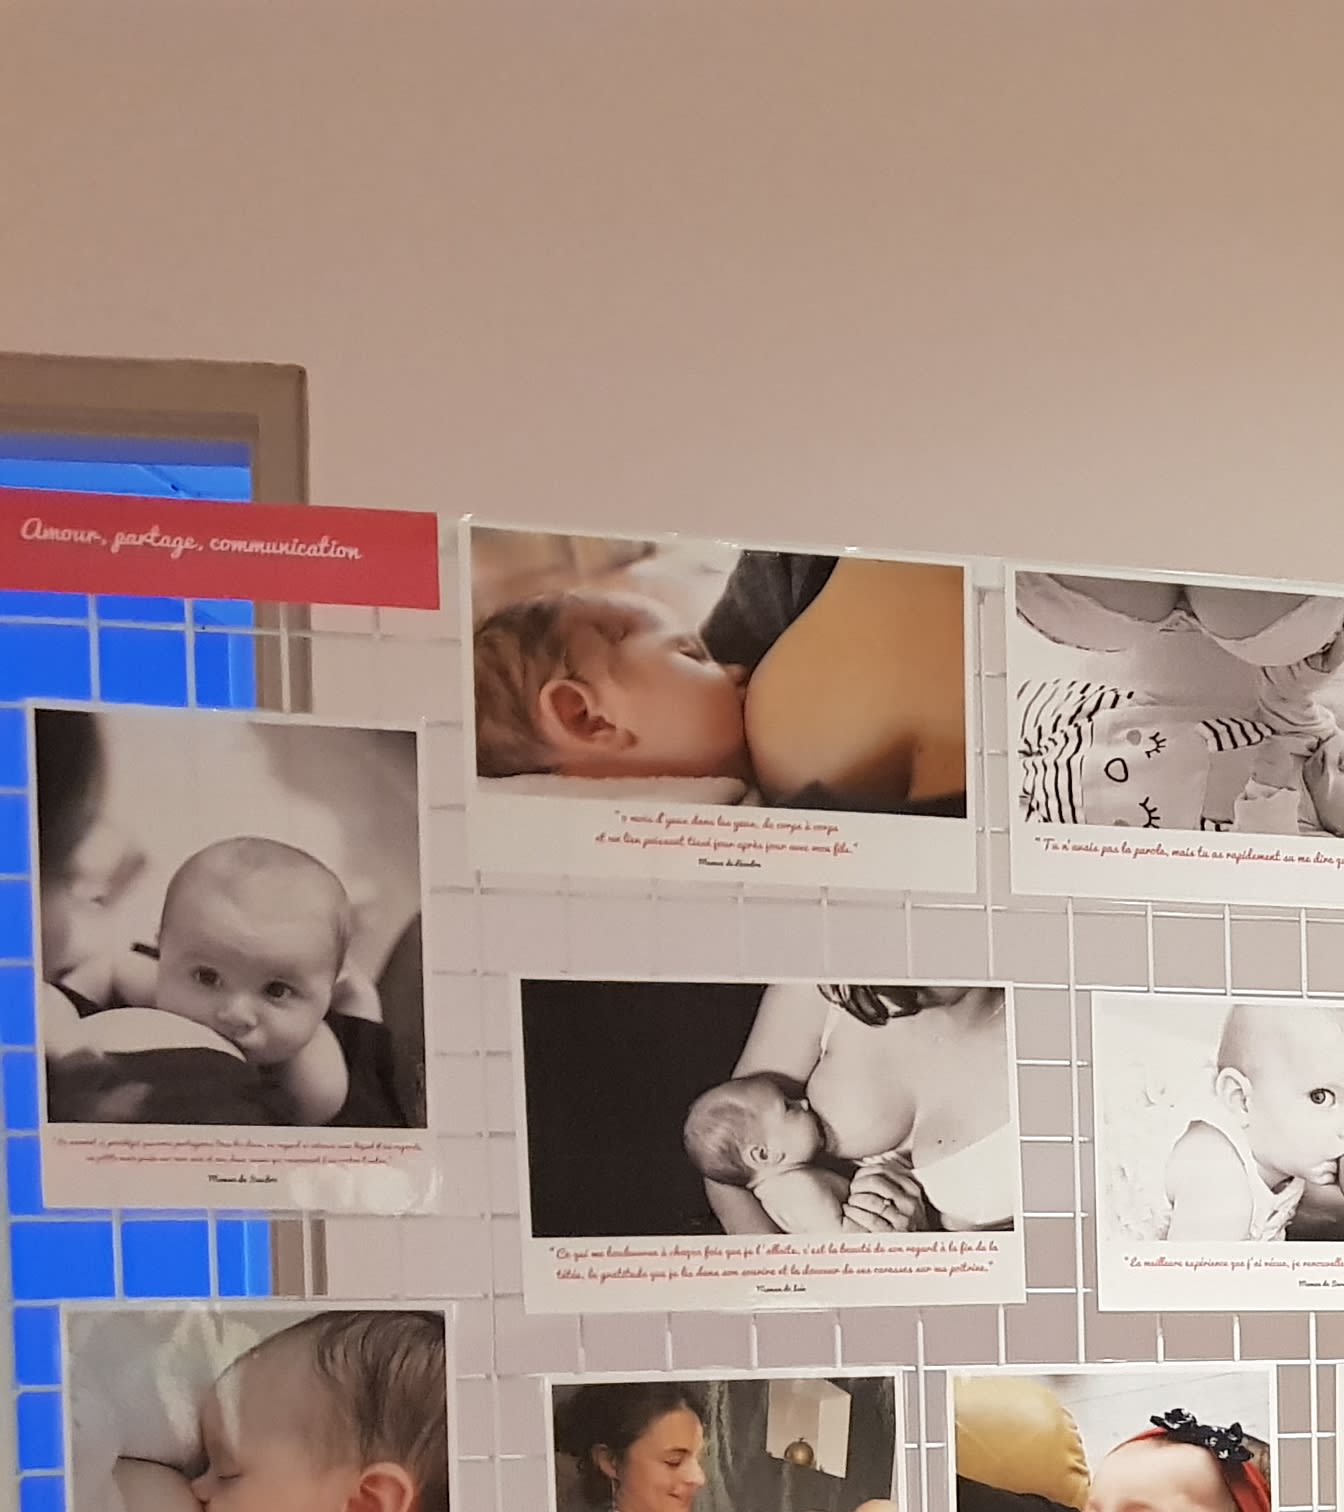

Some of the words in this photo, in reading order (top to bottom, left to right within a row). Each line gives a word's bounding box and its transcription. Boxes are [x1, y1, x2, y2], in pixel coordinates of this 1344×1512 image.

[21, 518, 107, 545] Amour,
[111, 526, 203, 557] partage,
[210, 536, 362, 559] communication
[1101, 847, 1119, 856] pas
[1122, 842, 1131, 853] la
[1172, 848, 1194, 856] mais
[1198, 846, 1209, 857] tu
[1226, 848, 1280, 864] rapidement
